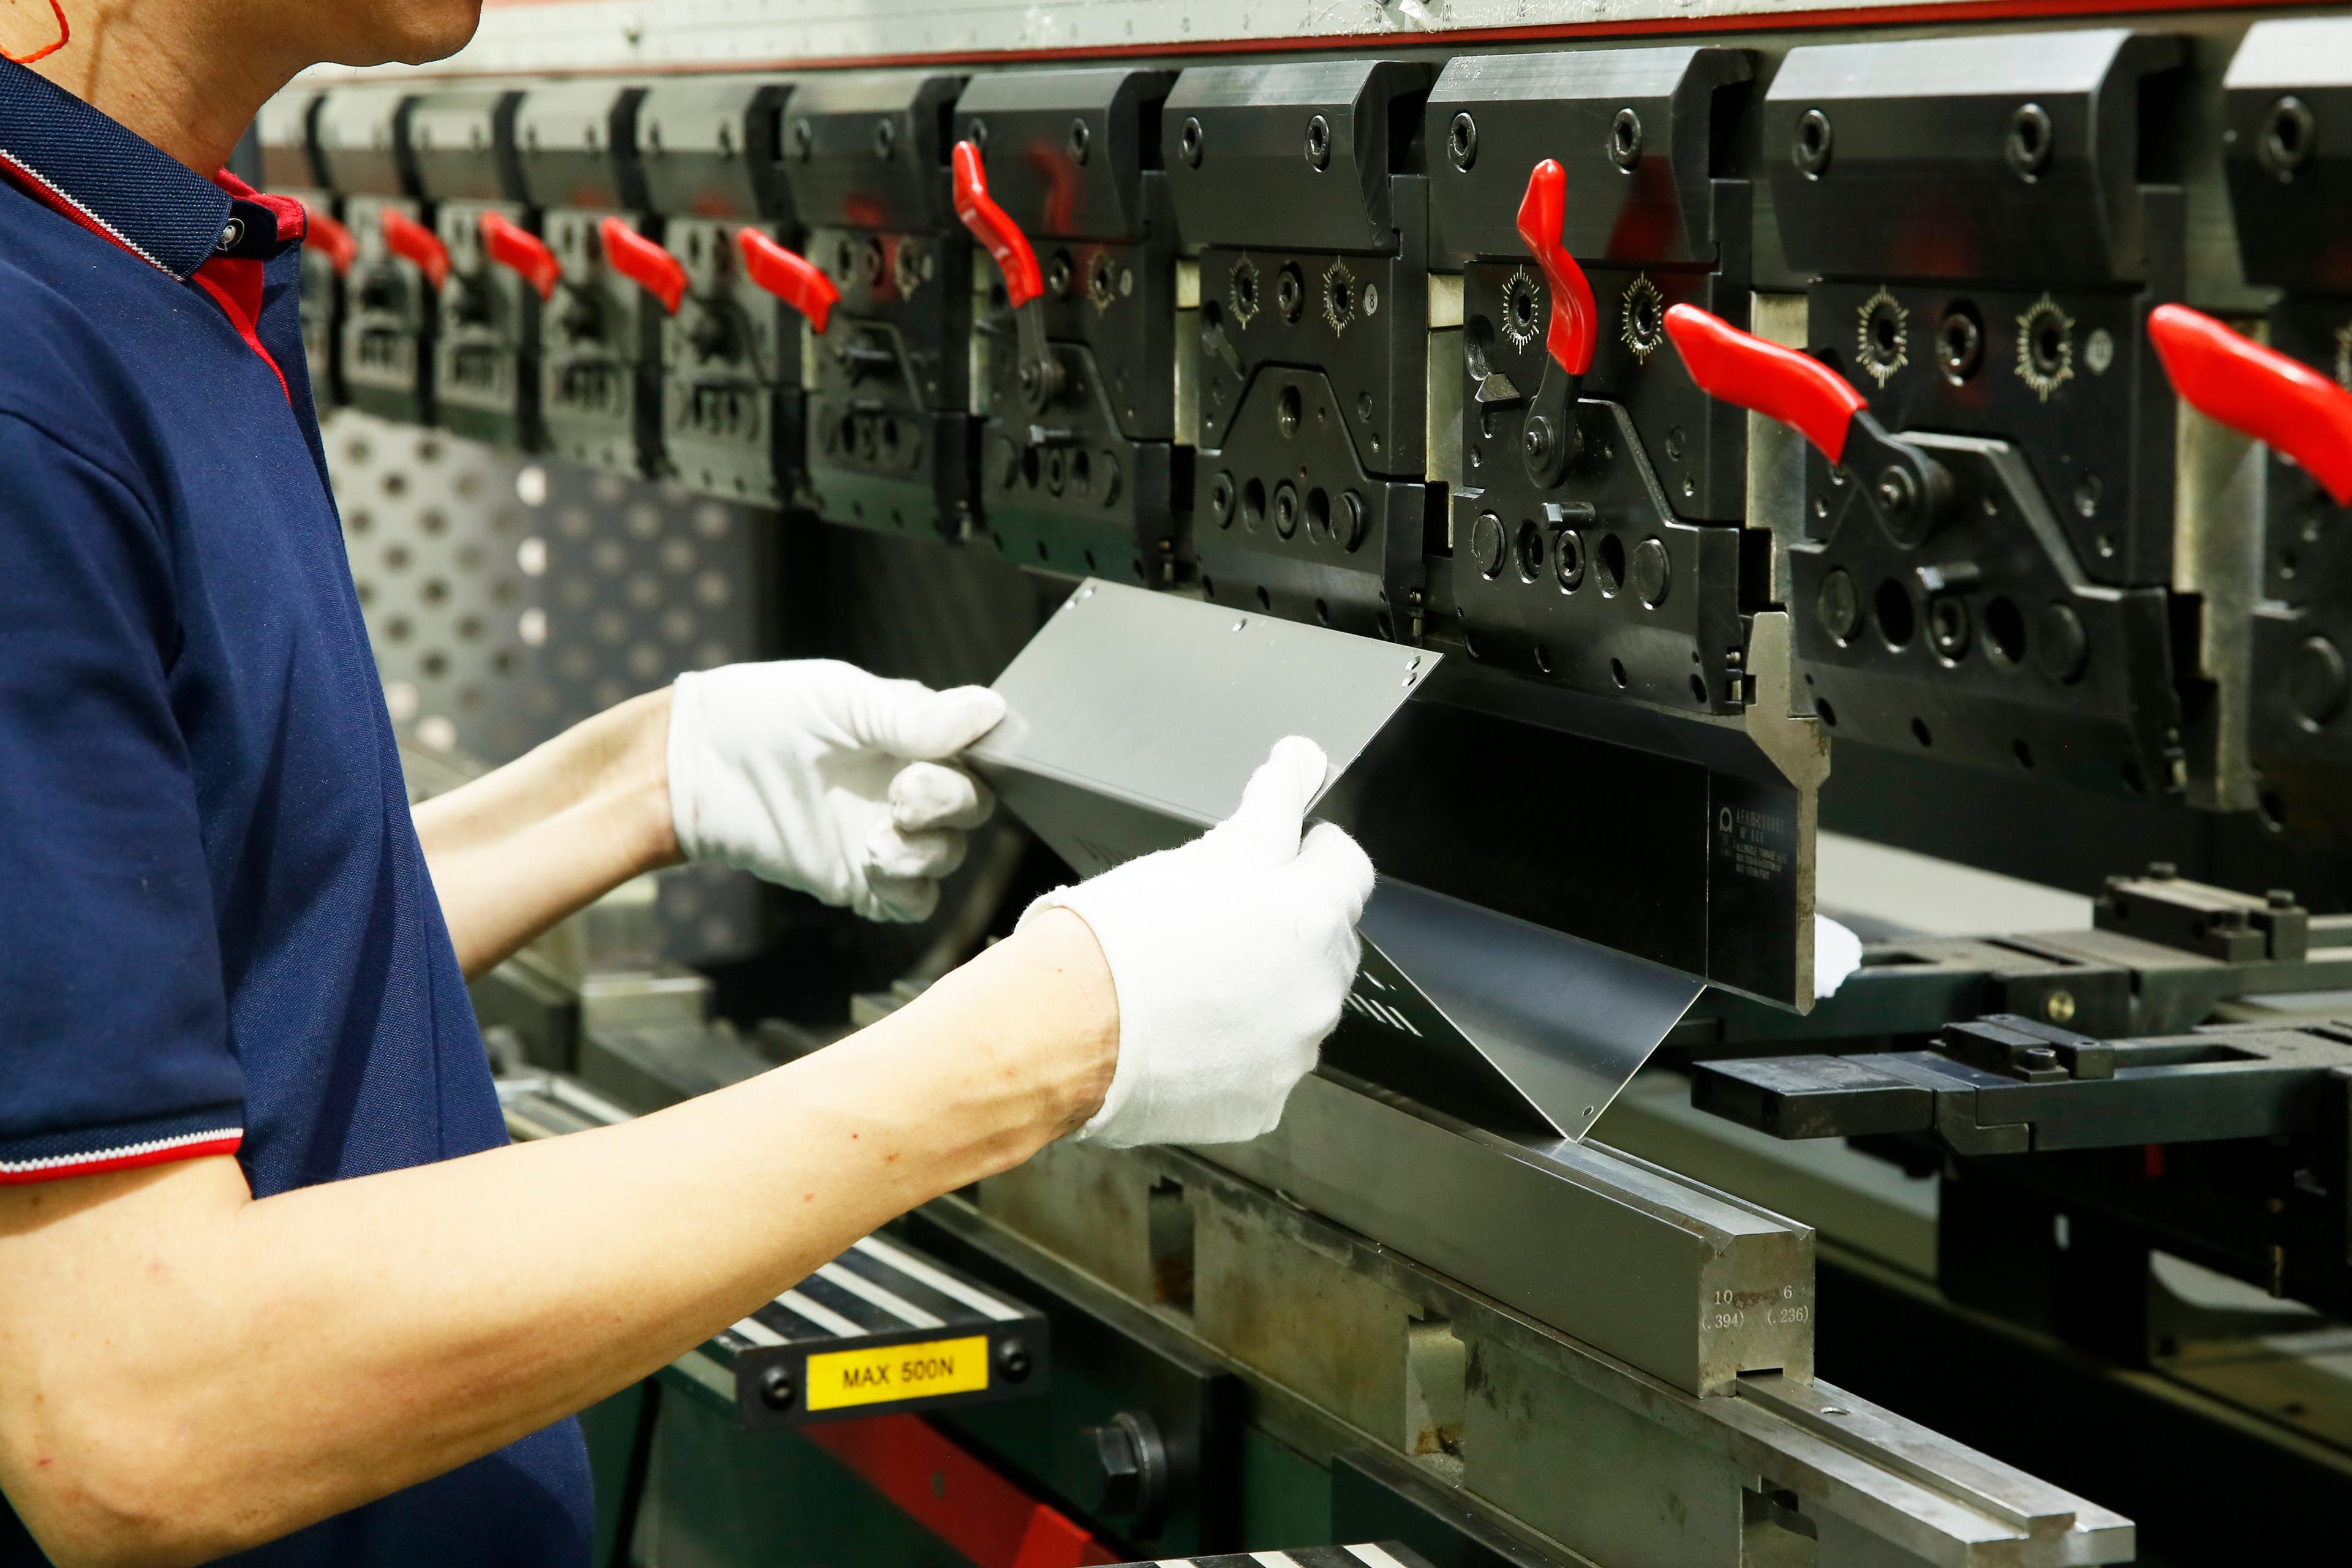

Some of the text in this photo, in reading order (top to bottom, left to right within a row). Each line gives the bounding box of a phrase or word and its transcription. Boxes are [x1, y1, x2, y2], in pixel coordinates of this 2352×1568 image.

[1370, 293, 1374, 309] 8
[1715, 1289, 1733, 1305] 10
[1783, 1284, 1793, 1299] 6
[843, 1357, 954, 1389] MAX 500N
